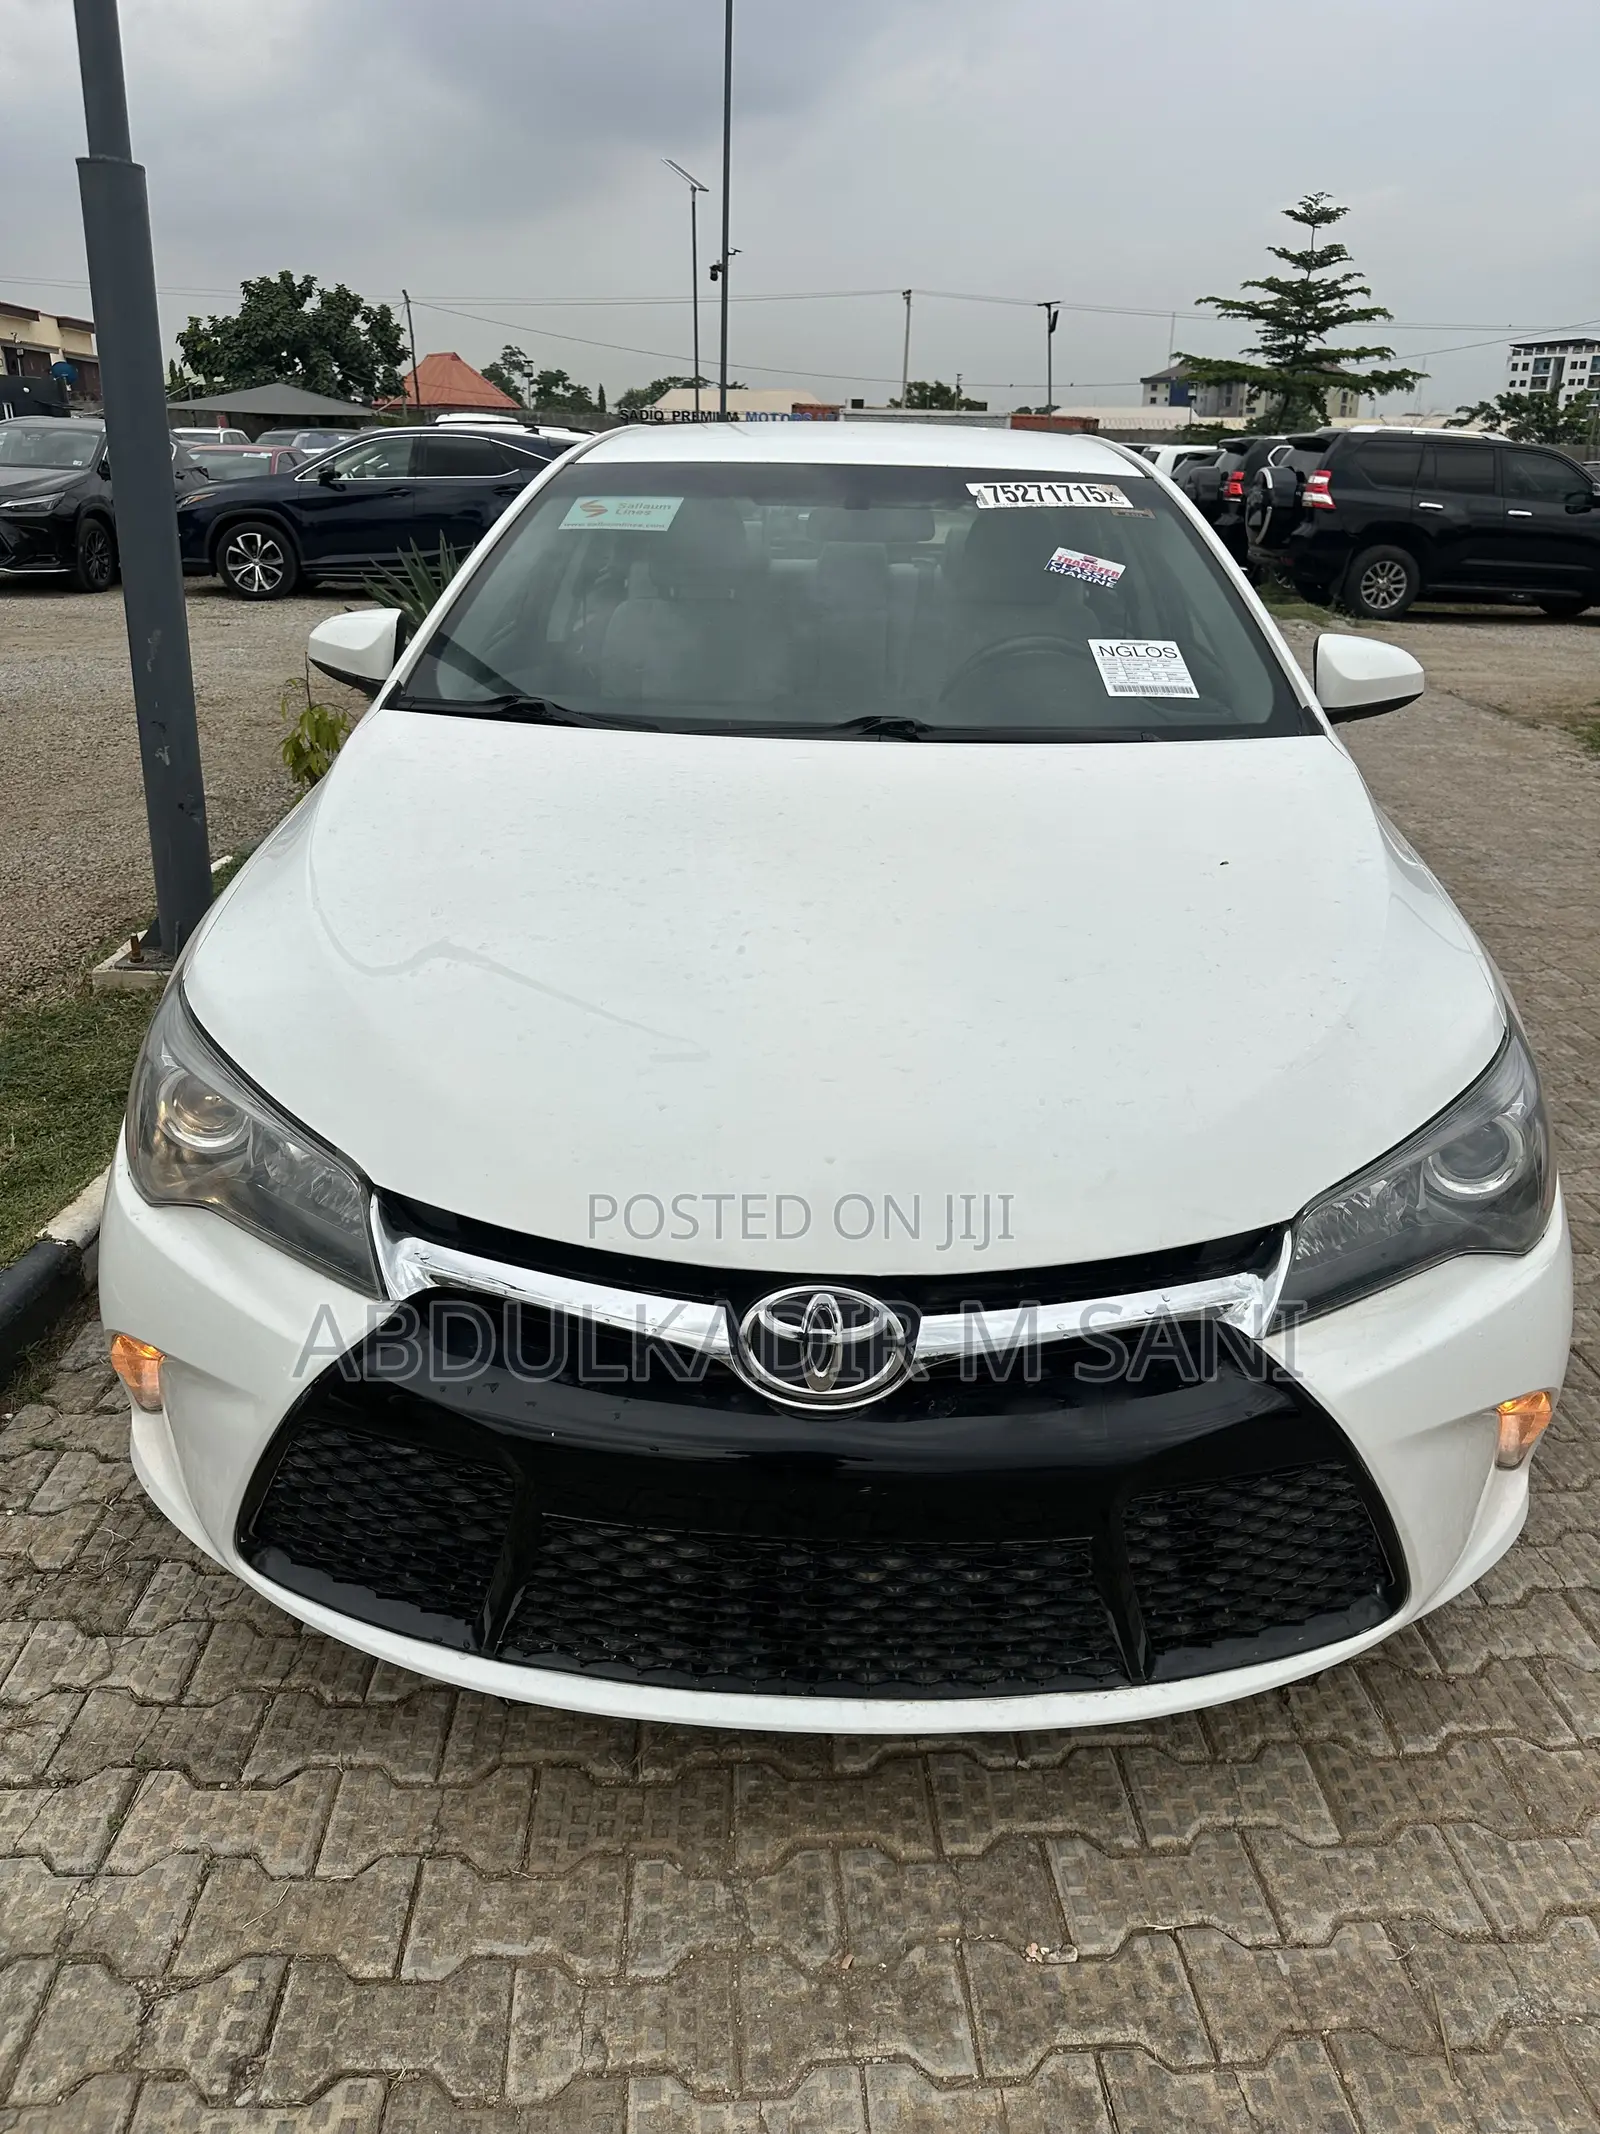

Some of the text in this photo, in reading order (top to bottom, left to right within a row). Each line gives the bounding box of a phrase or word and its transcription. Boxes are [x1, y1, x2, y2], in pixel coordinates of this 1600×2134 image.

[619, 408, 664, 421] SADIQ
[618, 501, 672, 510] Sallaum
[1051, 560, 1119, 584] CLASSIC
[1056, 555, 1120, 578] TRANSFER
[1049, 566, 1115, 589] MARINE
[1098, 645, 1178, 659] NGLOS
